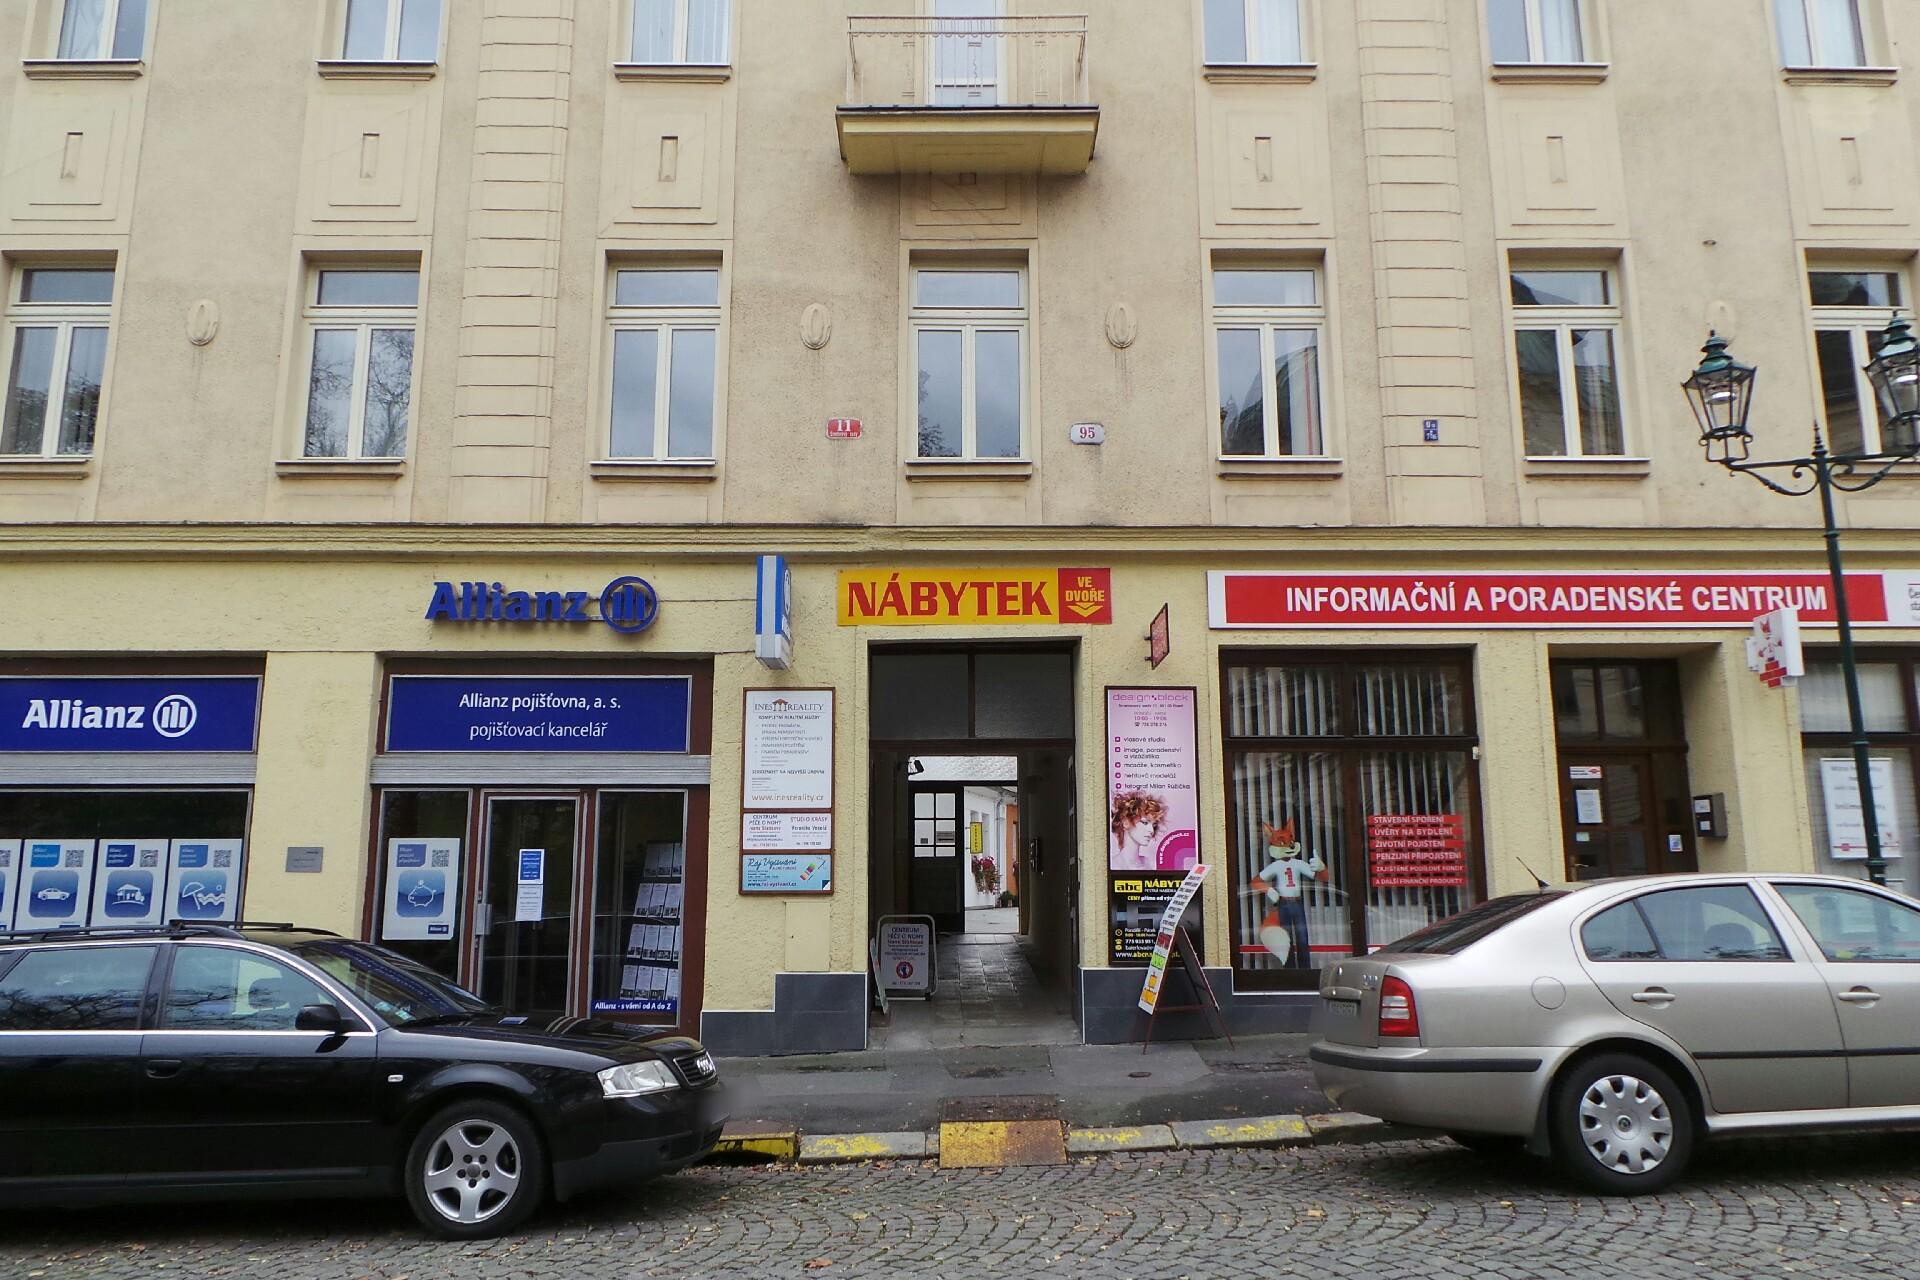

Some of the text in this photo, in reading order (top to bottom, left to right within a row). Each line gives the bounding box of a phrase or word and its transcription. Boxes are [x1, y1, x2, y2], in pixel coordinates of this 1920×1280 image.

[838, 420, 850, 431] 11
[1080, 426, 1095, 439] 95
[1077, 576, 1093, 587] VE
[847, 572, 1053, 617] NÁBYTEK
[1065, 587, 1105, 602] DVOŘE
[1286, 581, 1828, 612] INFORMAČNÍ A PORADENSKÉ CENTRUM
[424, 581, 588, 621] Allianz
[458, 692, 622, 712] Allianz pojišťovna, a. s.
[22, 699, 145, 729] Allianz
[470, 721, 609, 740] pojišťovací kancelář
[752, 793, 824, 802] www.inesreality.cz
[1374, 816, 1410, 824] STAVEBNÍ
[1374, 827, 1400, 836] ÚVĚRY
[1416, 826, 1453, 834] BYDLENÍ
[1375, 839, 1446, 848] ŽIVOTNÍ POJIŠTĚNÍ
[1376, 851, 1462, 860] PENZIJNÍ PŘIPOJIŠTĚNÍ
[1116, 882, 1142, 892] abc
[594, 1002, 616, 1010] Allianz
[626, 1002, 642, 1010] vámi
[642, 1002, 650, 1010] od
[650, 1002, 656, 1010] A
[656, 1002, 666, 1010] do
[666, 1002, 672, 1010] Z
